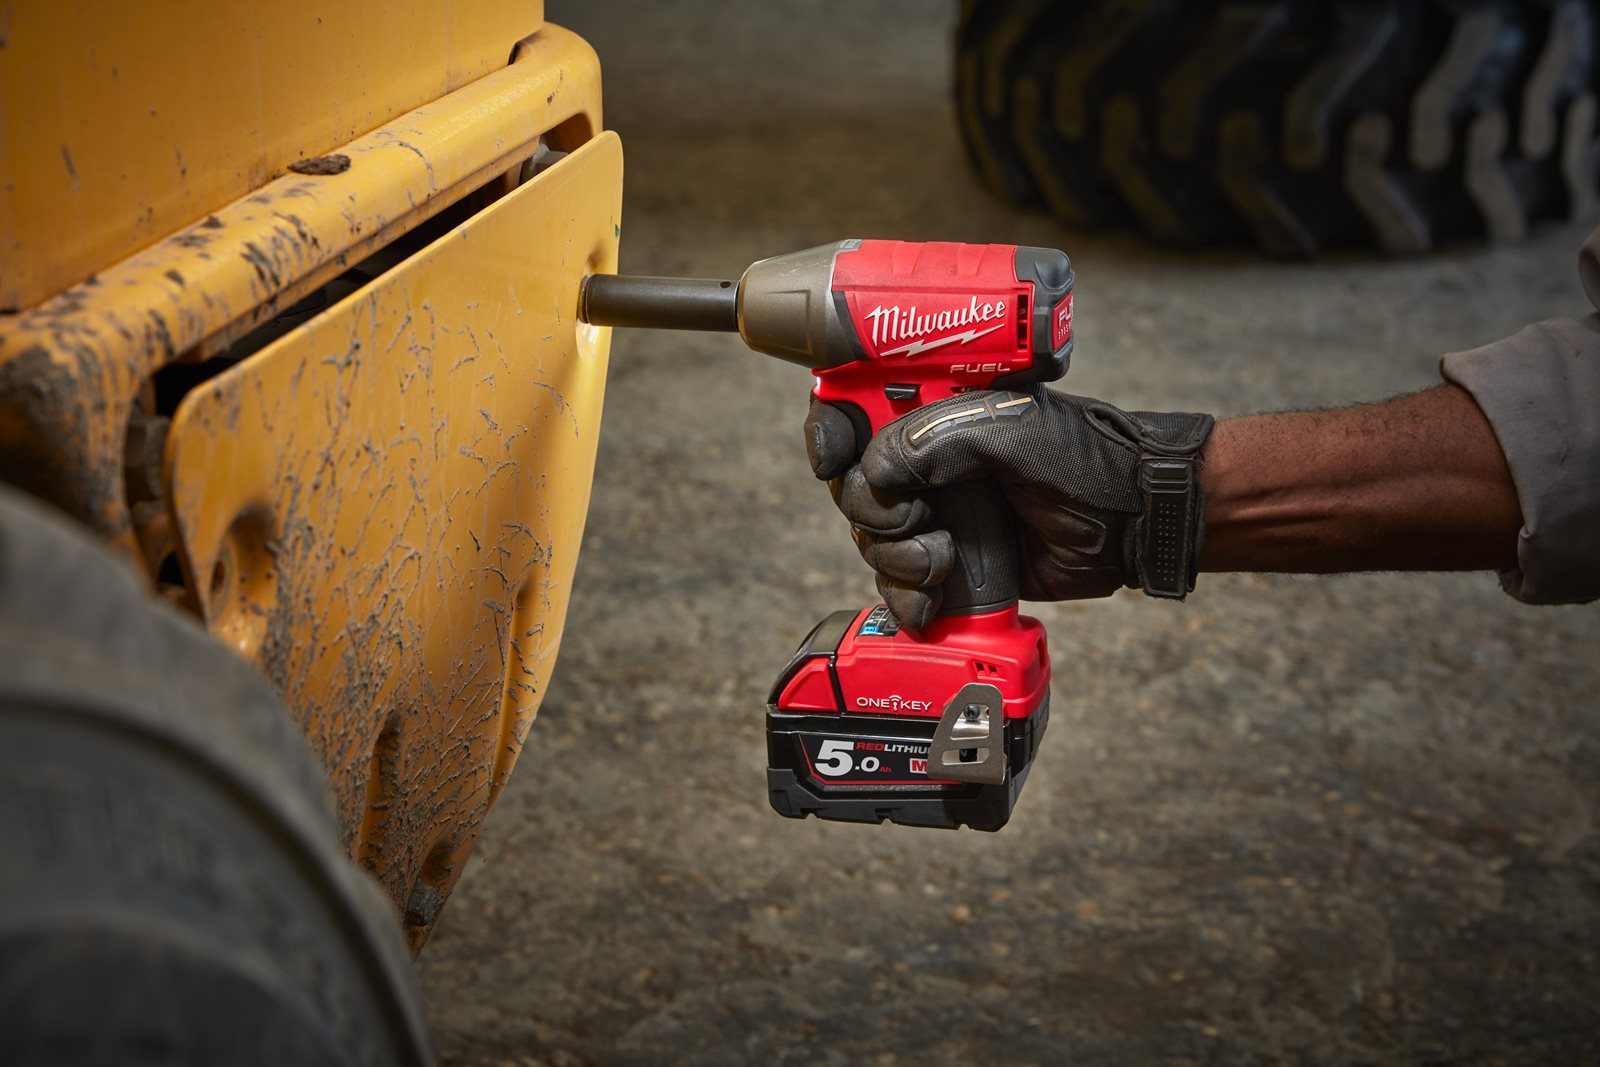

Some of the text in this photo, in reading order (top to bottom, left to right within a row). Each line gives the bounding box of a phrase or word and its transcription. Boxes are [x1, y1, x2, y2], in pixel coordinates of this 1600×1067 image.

[864, 295, 1006, 347] Milwaukee
[949, 363, 1010, 373] FUEL
[855, 742, 929, 754] REDLITHIU
[911, 759, 928, 772] M
